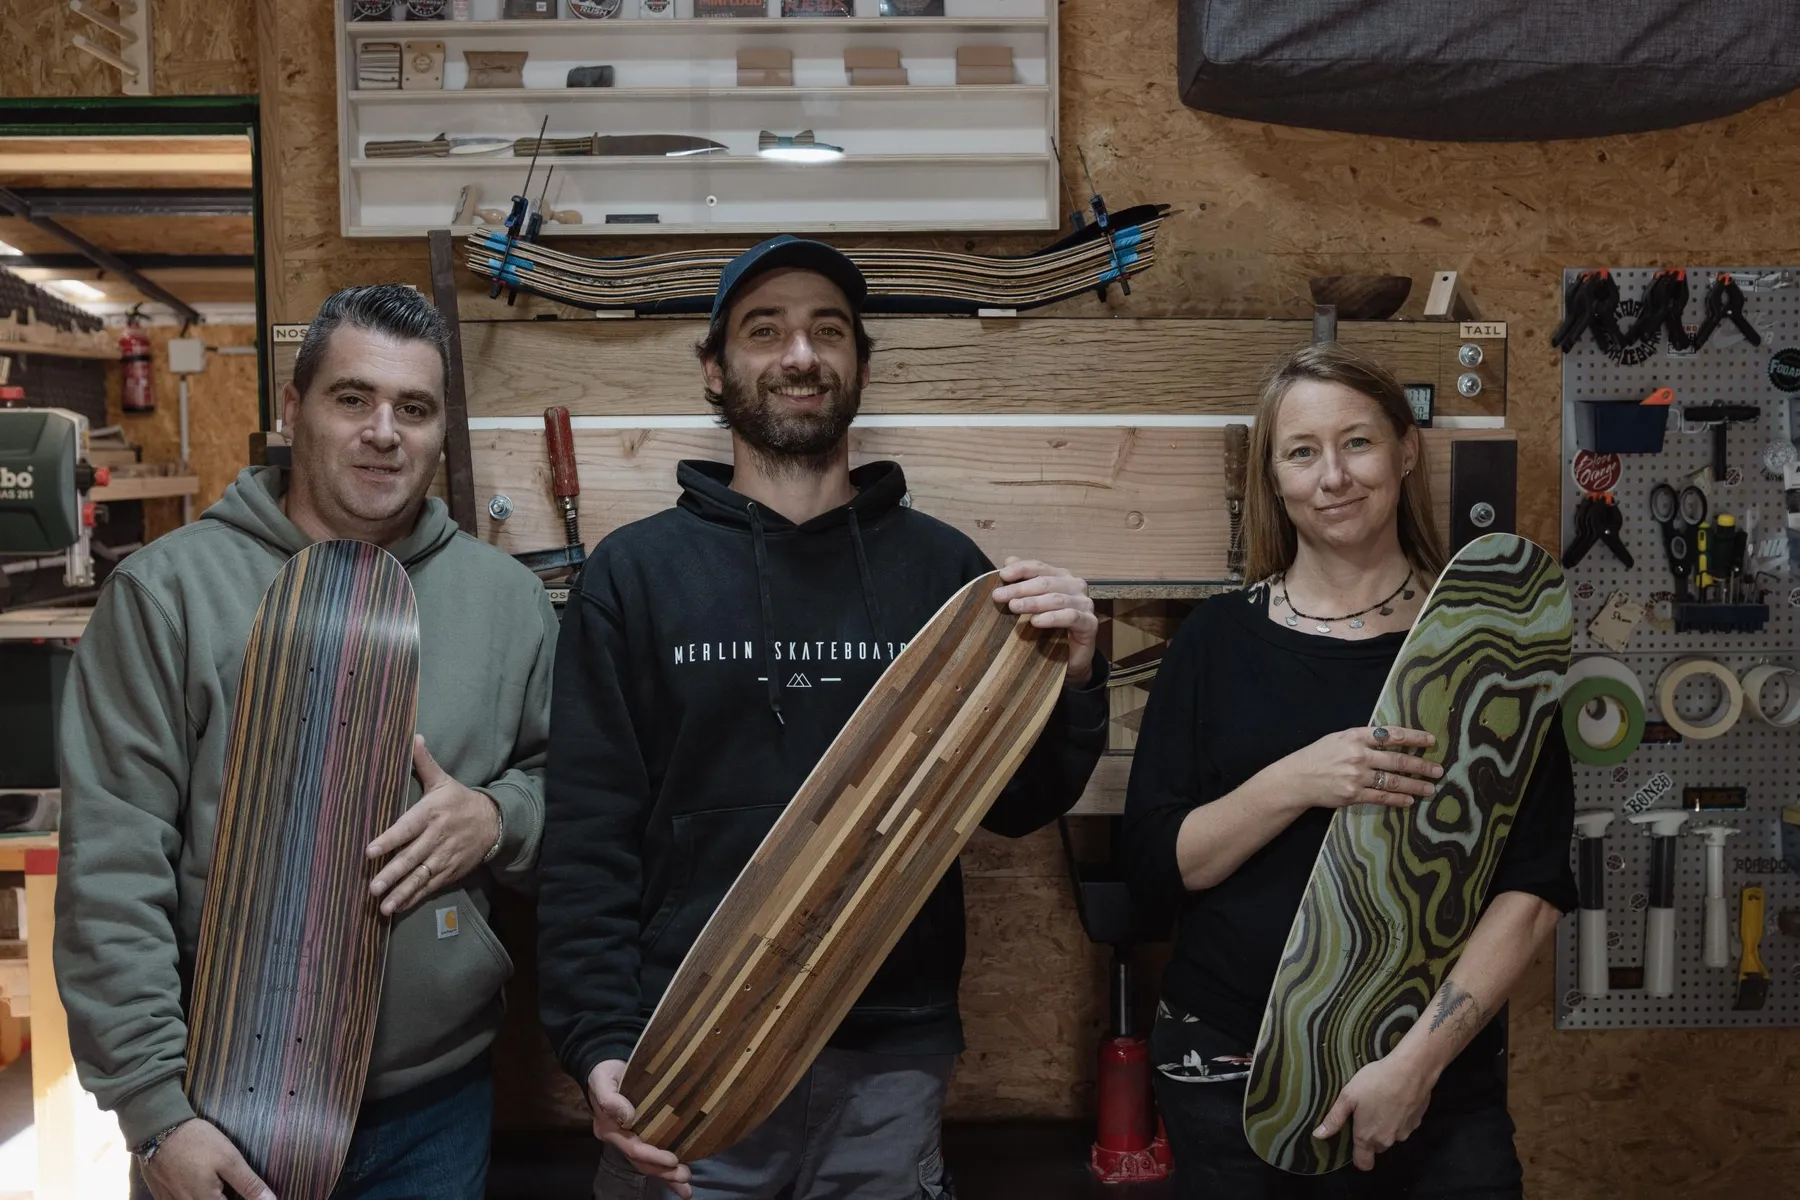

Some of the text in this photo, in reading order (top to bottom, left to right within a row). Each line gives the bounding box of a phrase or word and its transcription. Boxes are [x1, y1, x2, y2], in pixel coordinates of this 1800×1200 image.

[580, 6, 608, 16] RUSH
[276, 329, 308, 339] NOS
[1464, 325, 1501, 335] TAIL
[0, 467, 33, 488] bo
[1580, 462, 1617, 490] Orange
[674, 641, 753, 665] MERLIN
[1627, 774, 1671, 813] BONES
